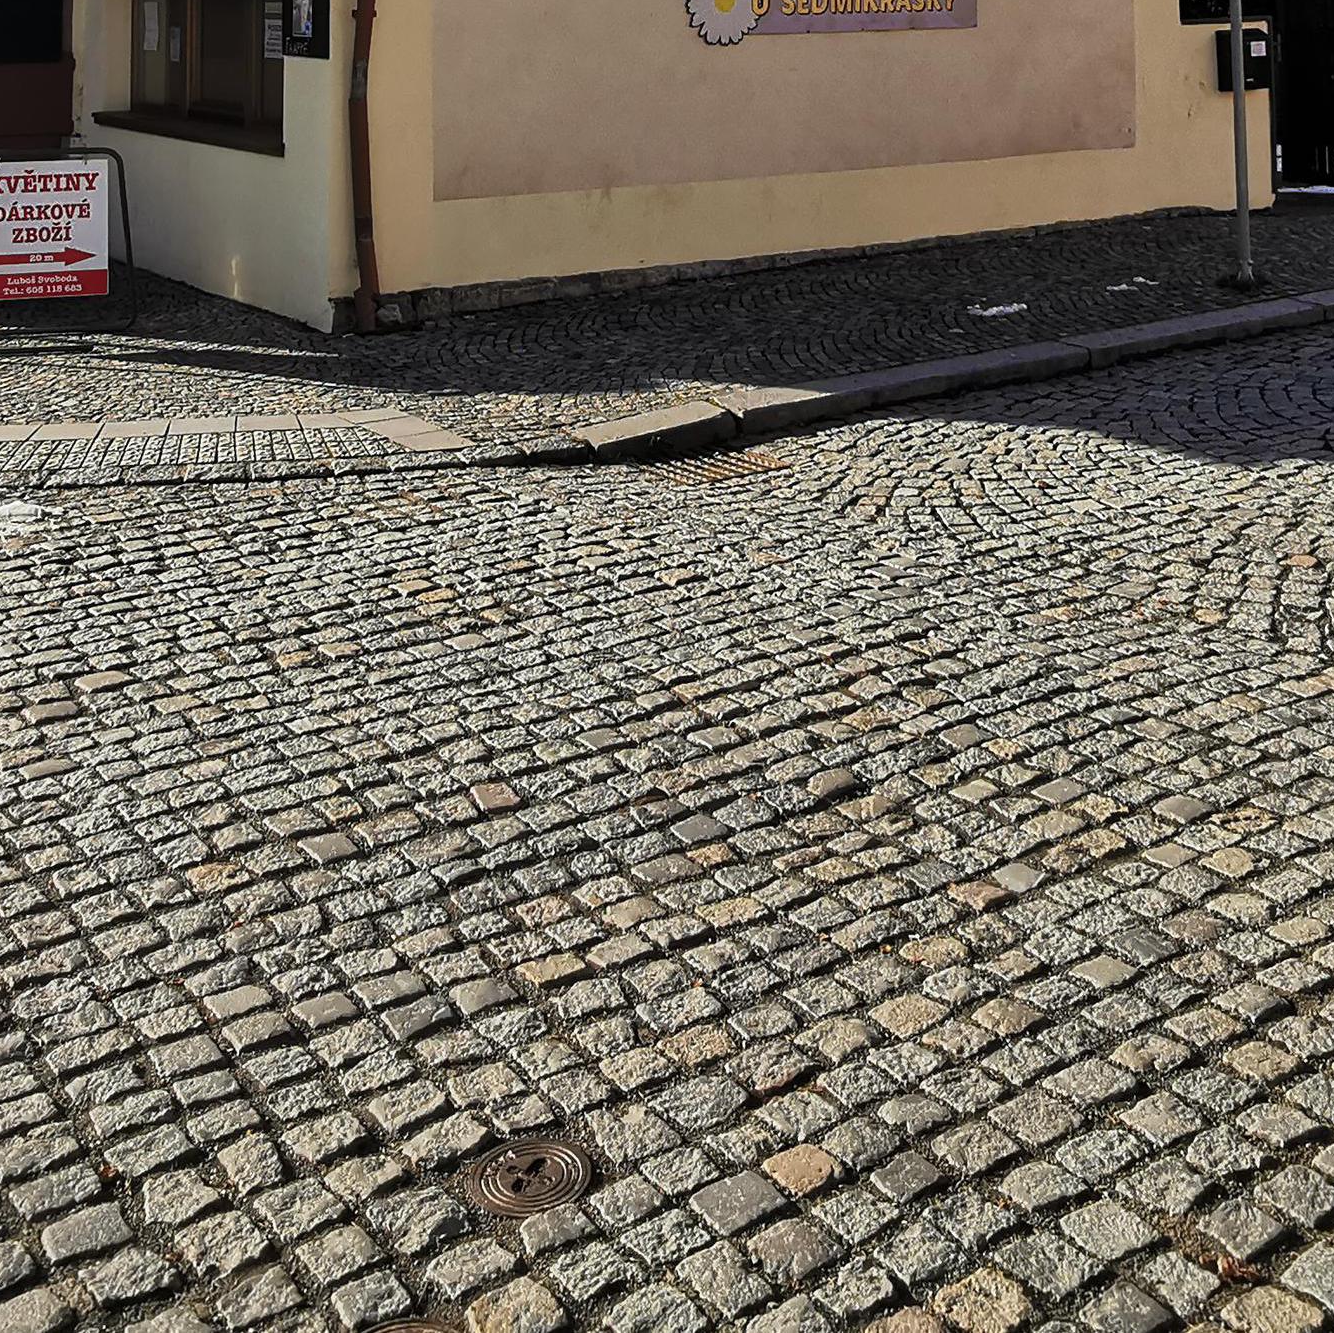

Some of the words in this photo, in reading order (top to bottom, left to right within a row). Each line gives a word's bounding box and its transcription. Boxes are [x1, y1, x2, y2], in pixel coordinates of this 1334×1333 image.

[11, 222, 73, 244] ZBOŽÍ
[29, 253, 42, 263] 20
[43, 254, 54, 262] m
[38, 274, 78, 284] Svoboda
